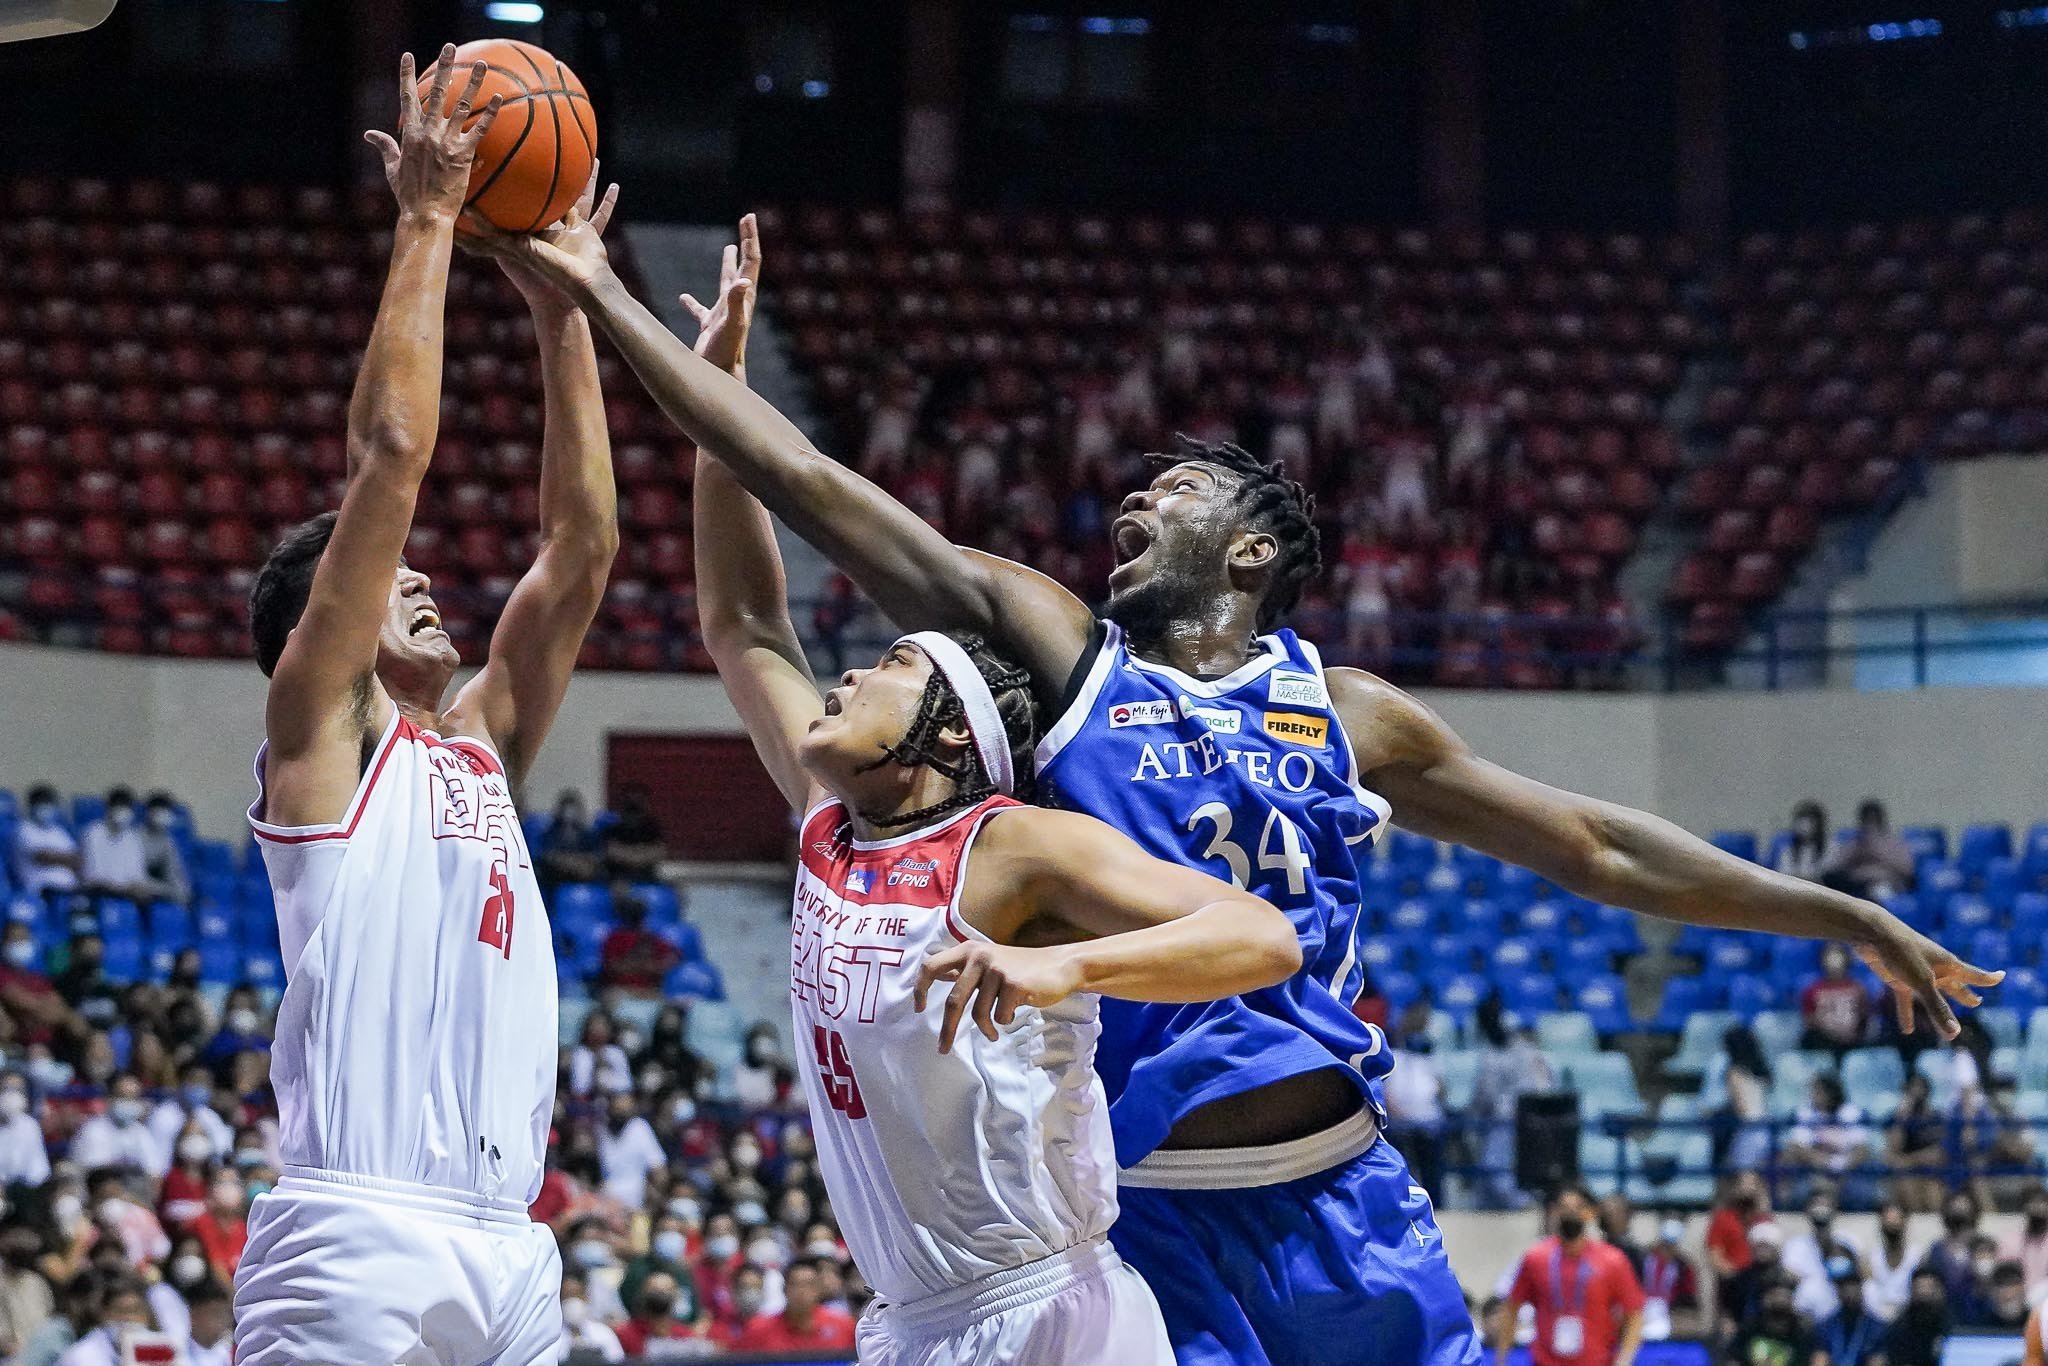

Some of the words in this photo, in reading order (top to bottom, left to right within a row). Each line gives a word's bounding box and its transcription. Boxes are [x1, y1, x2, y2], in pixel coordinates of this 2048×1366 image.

[1276, 690, 1321, 703] MASTERS
[1150, 704, 1169, 719] Fuji
[1268, 721, 1324, 739] FIREFLY
[1187, 802, 1311, 895] 34
[900, 873, 930, 888] PNB
[876, 917, 909, 937] THE
